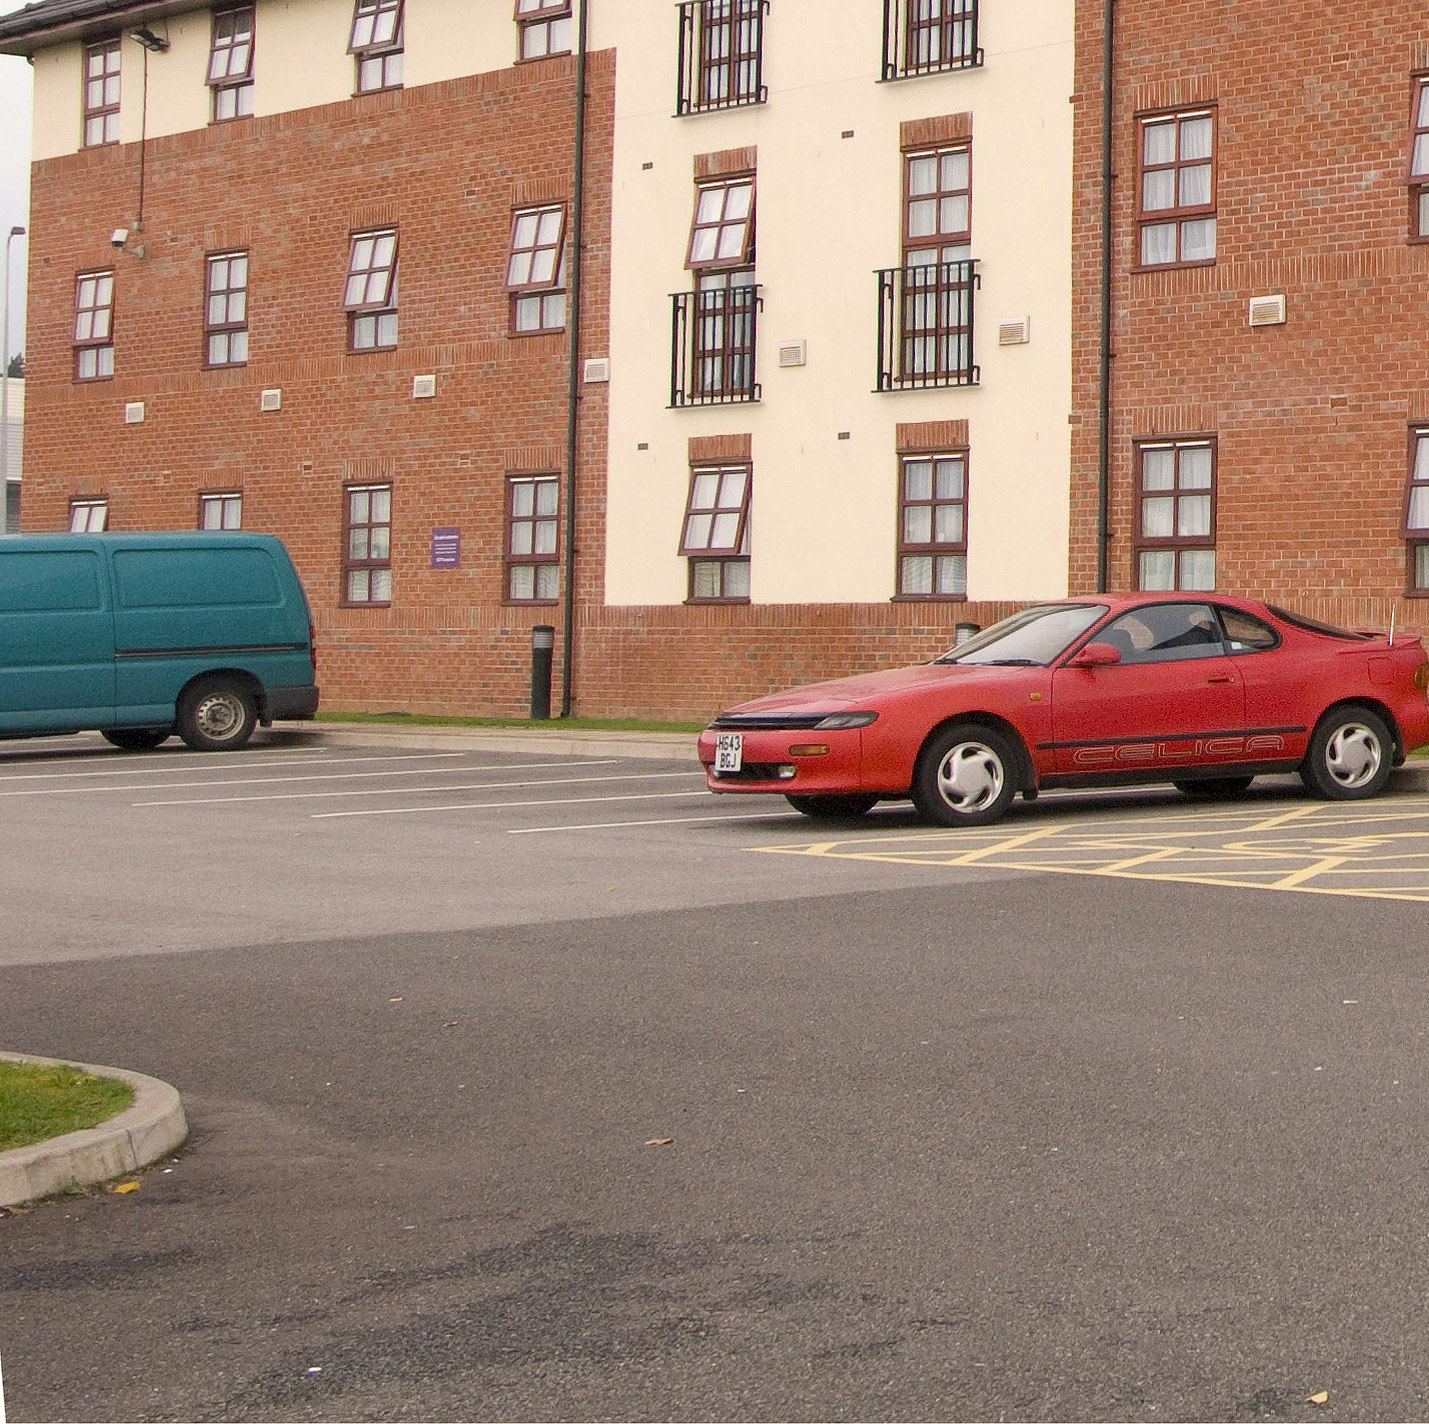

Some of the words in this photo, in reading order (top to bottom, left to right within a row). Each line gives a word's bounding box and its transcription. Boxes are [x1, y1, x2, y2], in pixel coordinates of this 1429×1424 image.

[718, 735, 741, 751] H643
[1072, 734, 1285, 764] CELICA
[720, 752, 737, 768] BGJ
